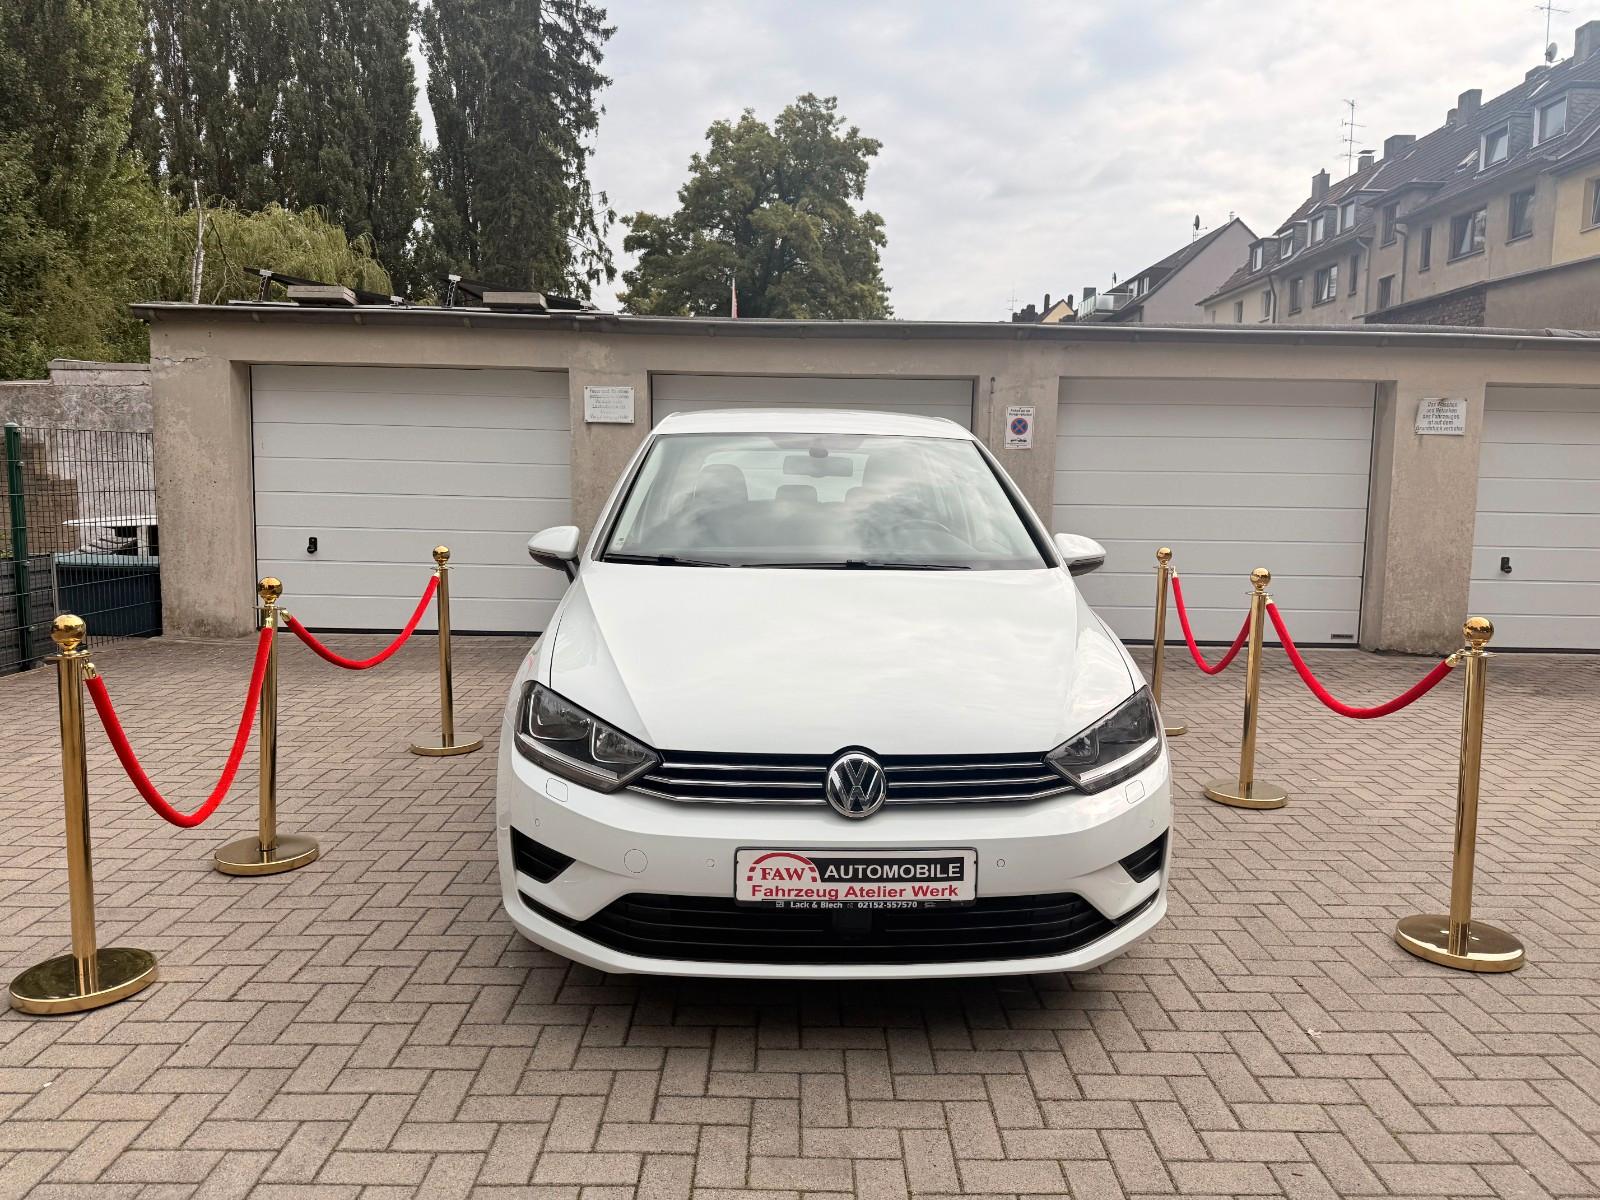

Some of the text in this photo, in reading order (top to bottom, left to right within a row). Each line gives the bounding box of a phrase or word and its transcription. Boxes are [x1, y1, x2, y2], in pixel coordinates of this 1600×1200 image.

[760, 863, 961, 881] FAW AUTOMOBILE
[751, 884, 959, 901] Fahrzeug Atelier Werk
[790, 901, 918, 909] Lack & Blech 02152-557570
